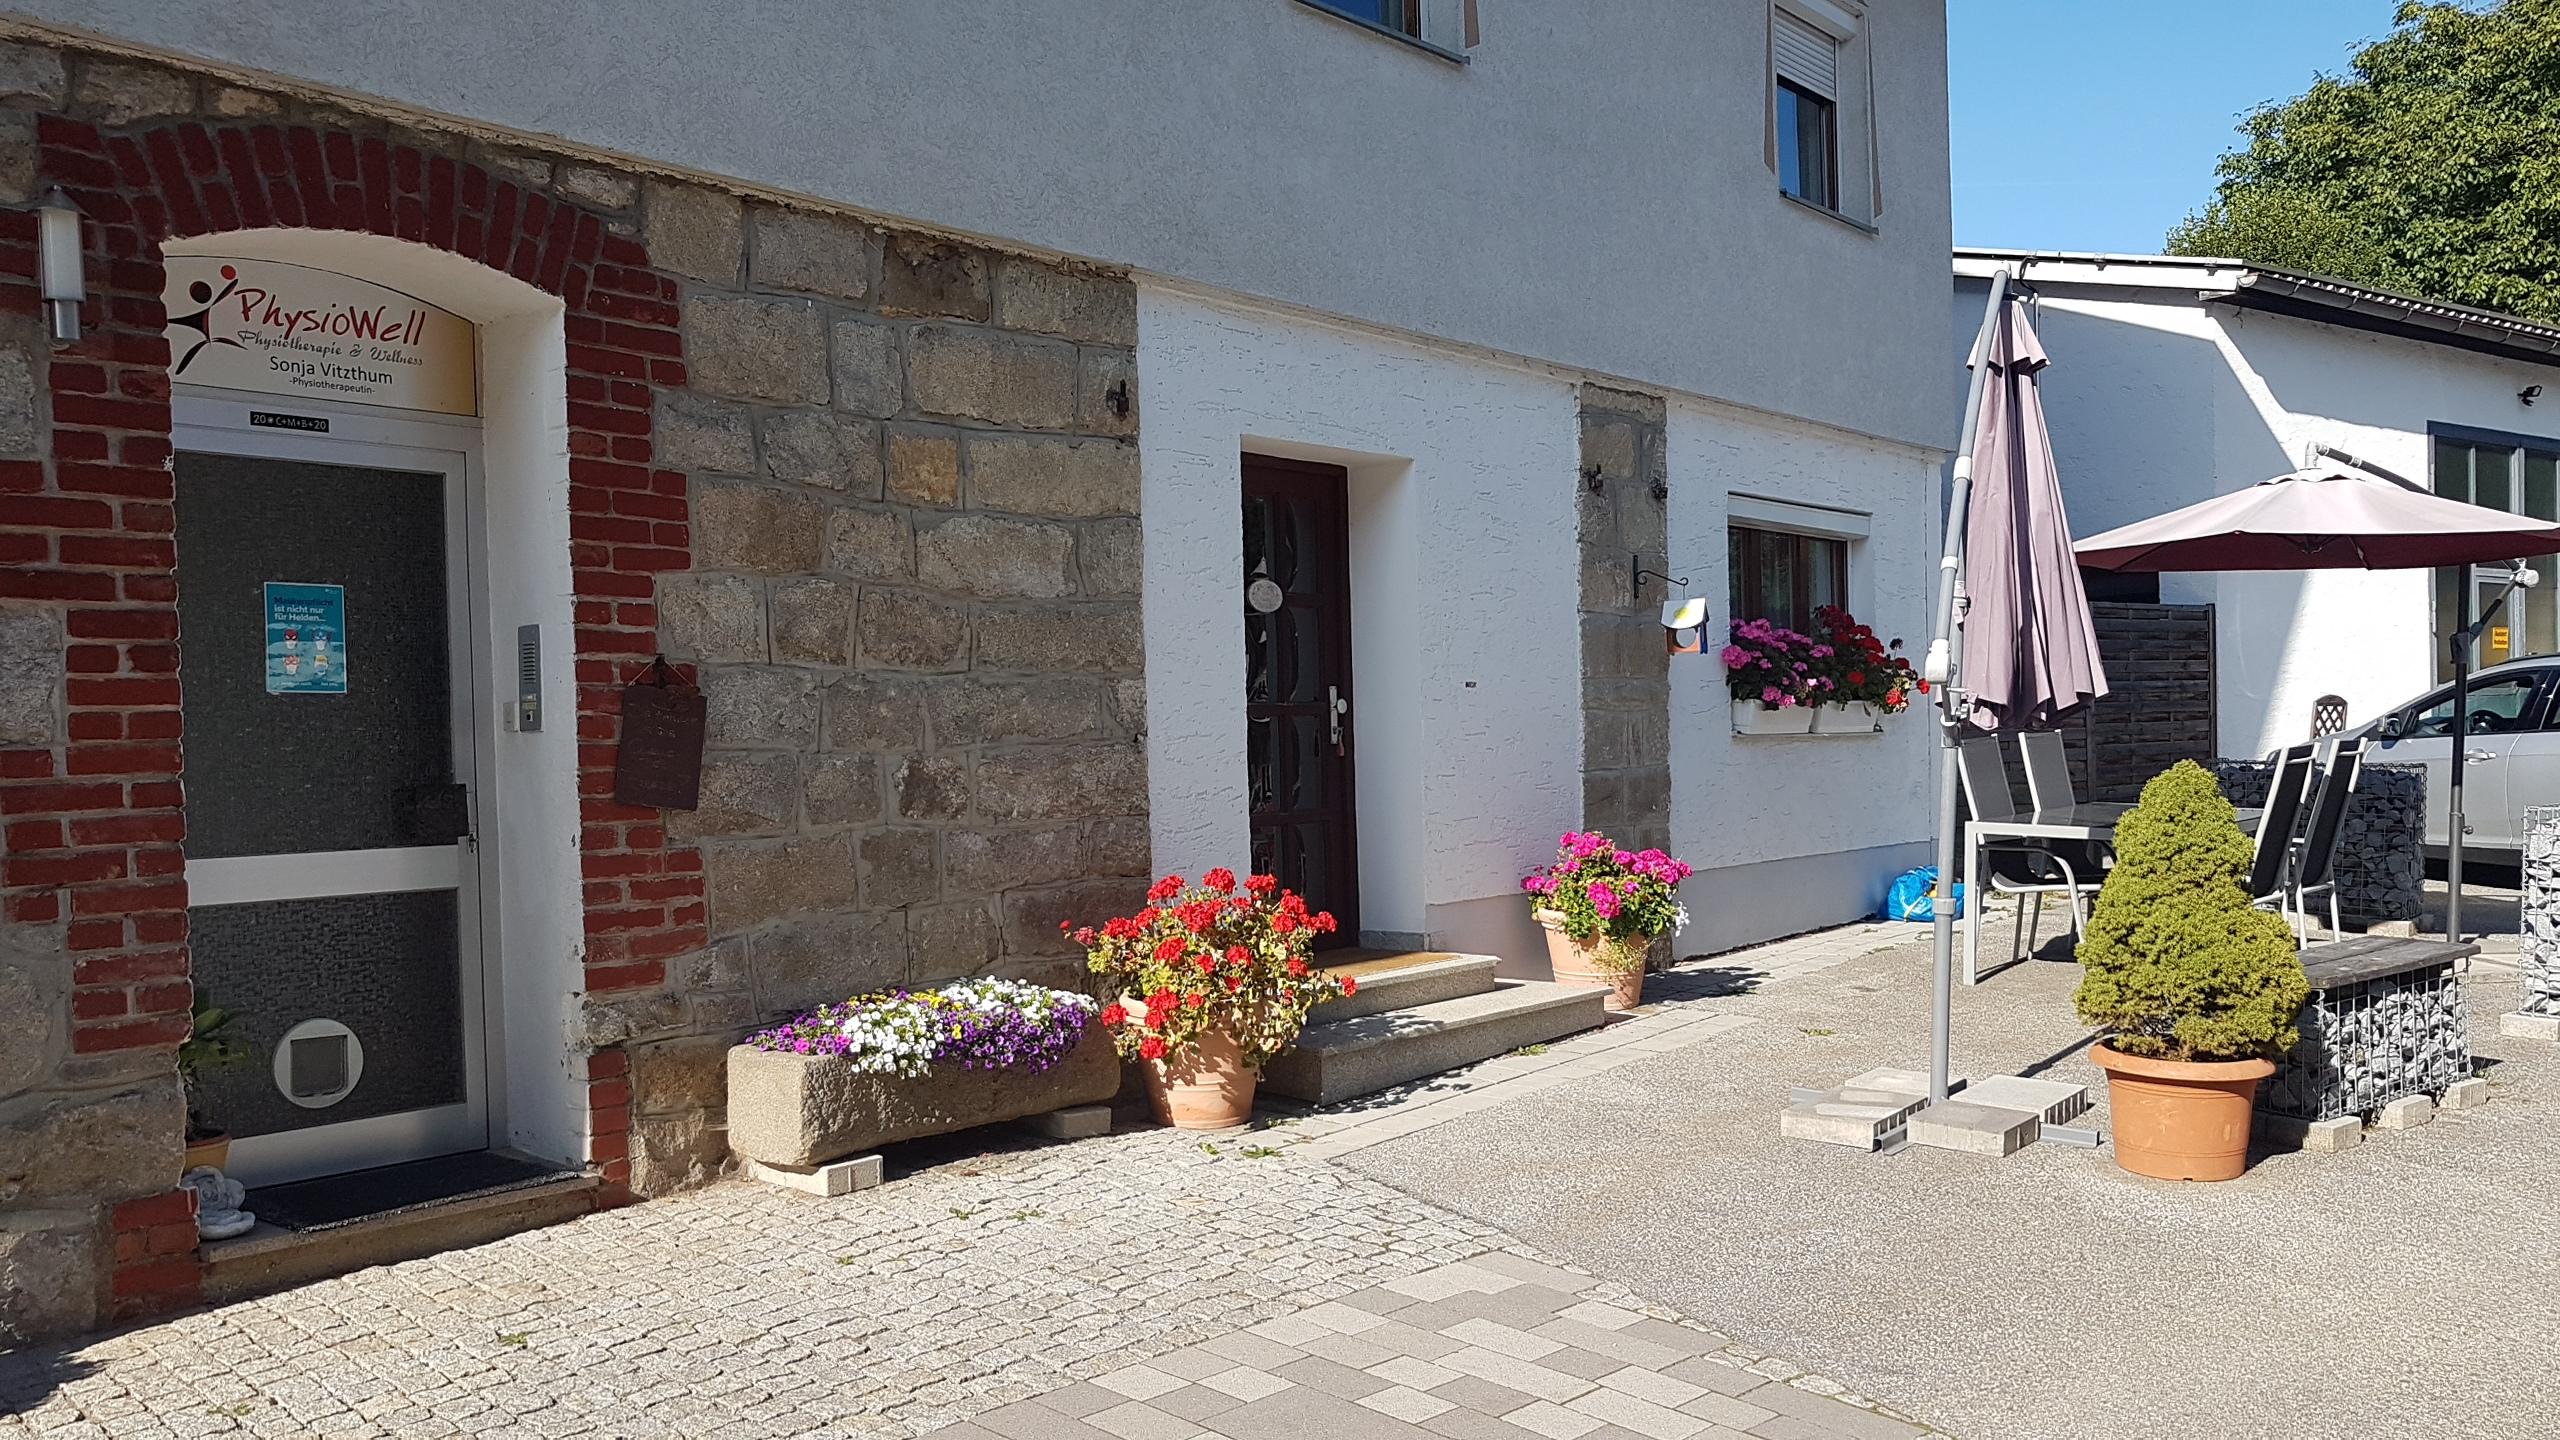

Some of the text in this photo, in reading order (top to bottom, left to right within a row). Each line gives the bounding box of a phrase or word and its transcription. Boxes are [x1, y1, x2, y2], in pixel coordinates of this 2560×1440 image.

[234, 288, 426, 346] PhysioWell
[237, 330, 424, 366] Physiotherapie & Wellness
[269, 355, 394, 385] Sonja Vitzthum
[274, 612, 287, 620] für
[286, 604, 308, 613] nicht
